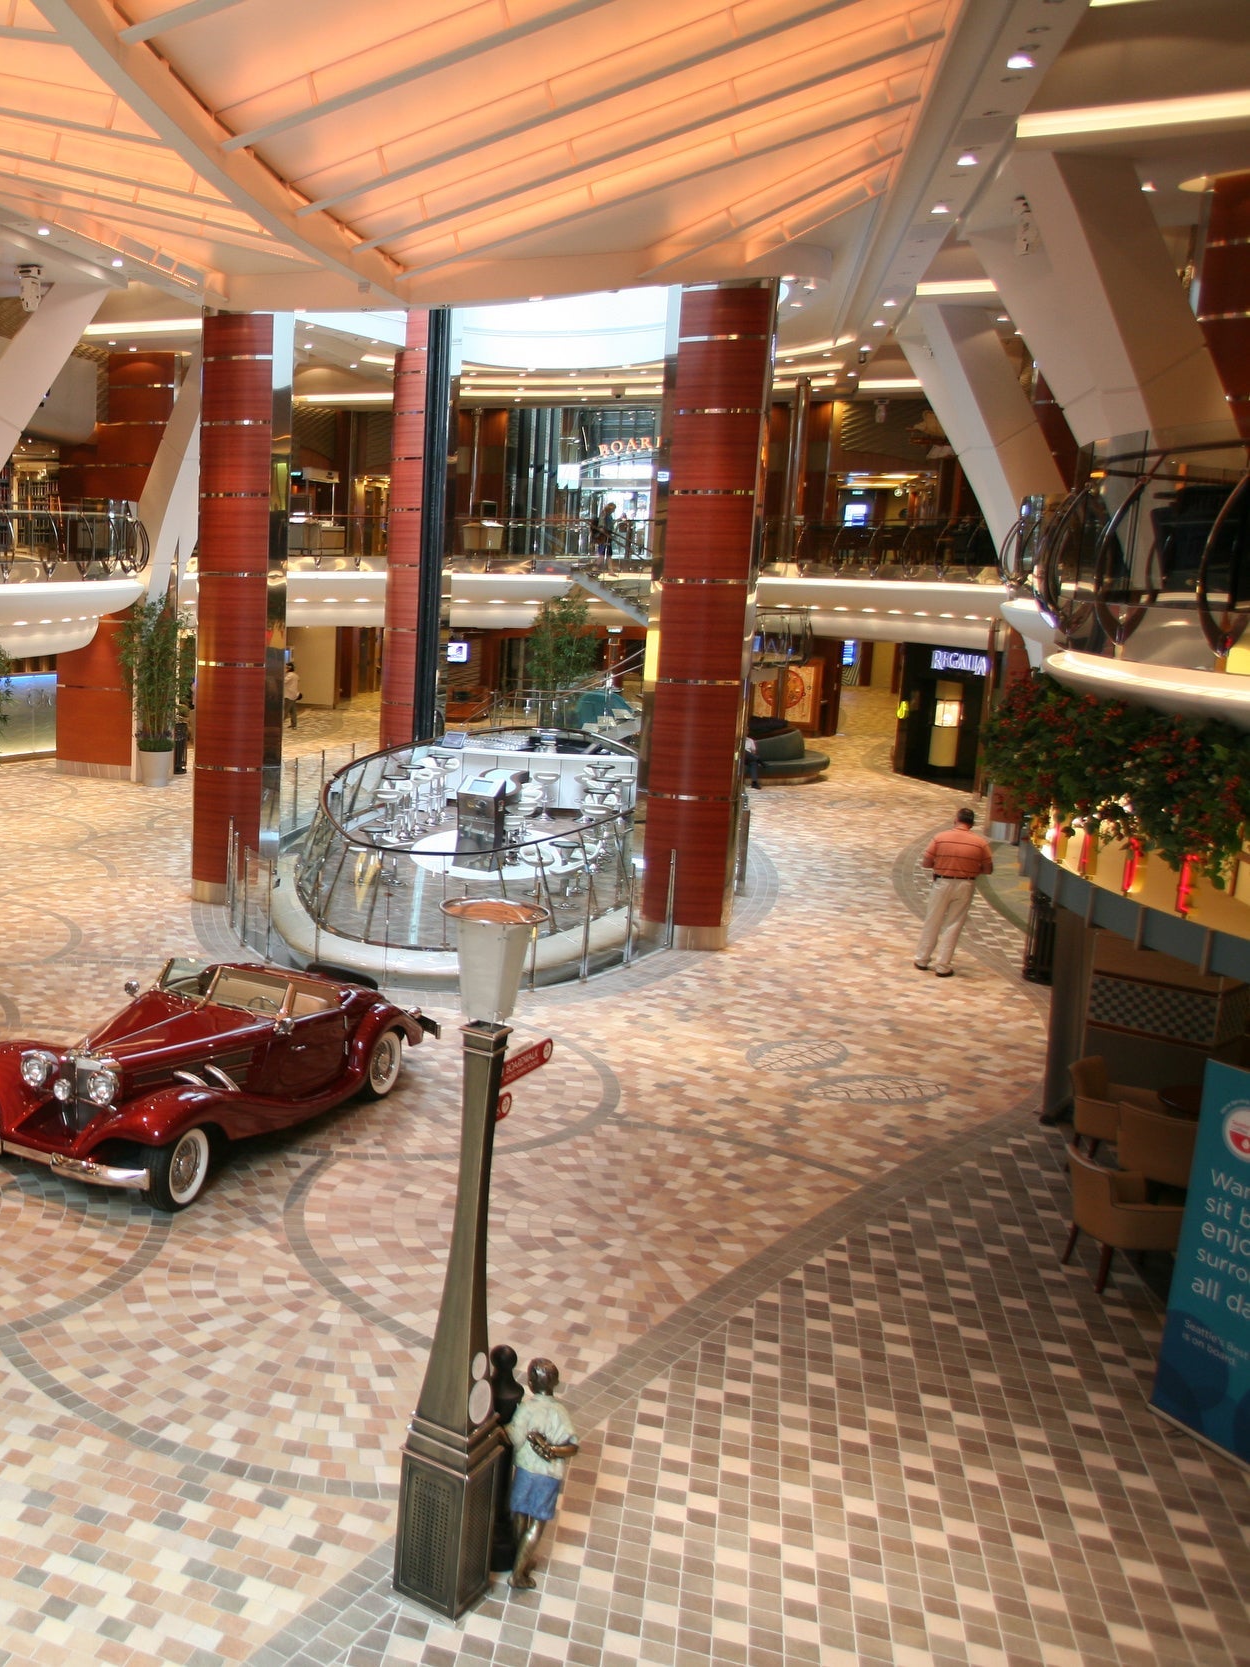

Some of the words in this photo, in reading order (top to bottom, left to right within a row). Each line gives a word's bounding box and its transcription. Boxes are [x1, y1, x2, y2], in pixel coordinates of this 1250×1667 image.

[1204, 1197, 1231, 1220] sit
[1191, 1276, 1218, 1301] all
[1192, 1337, 1205, 1349] on
